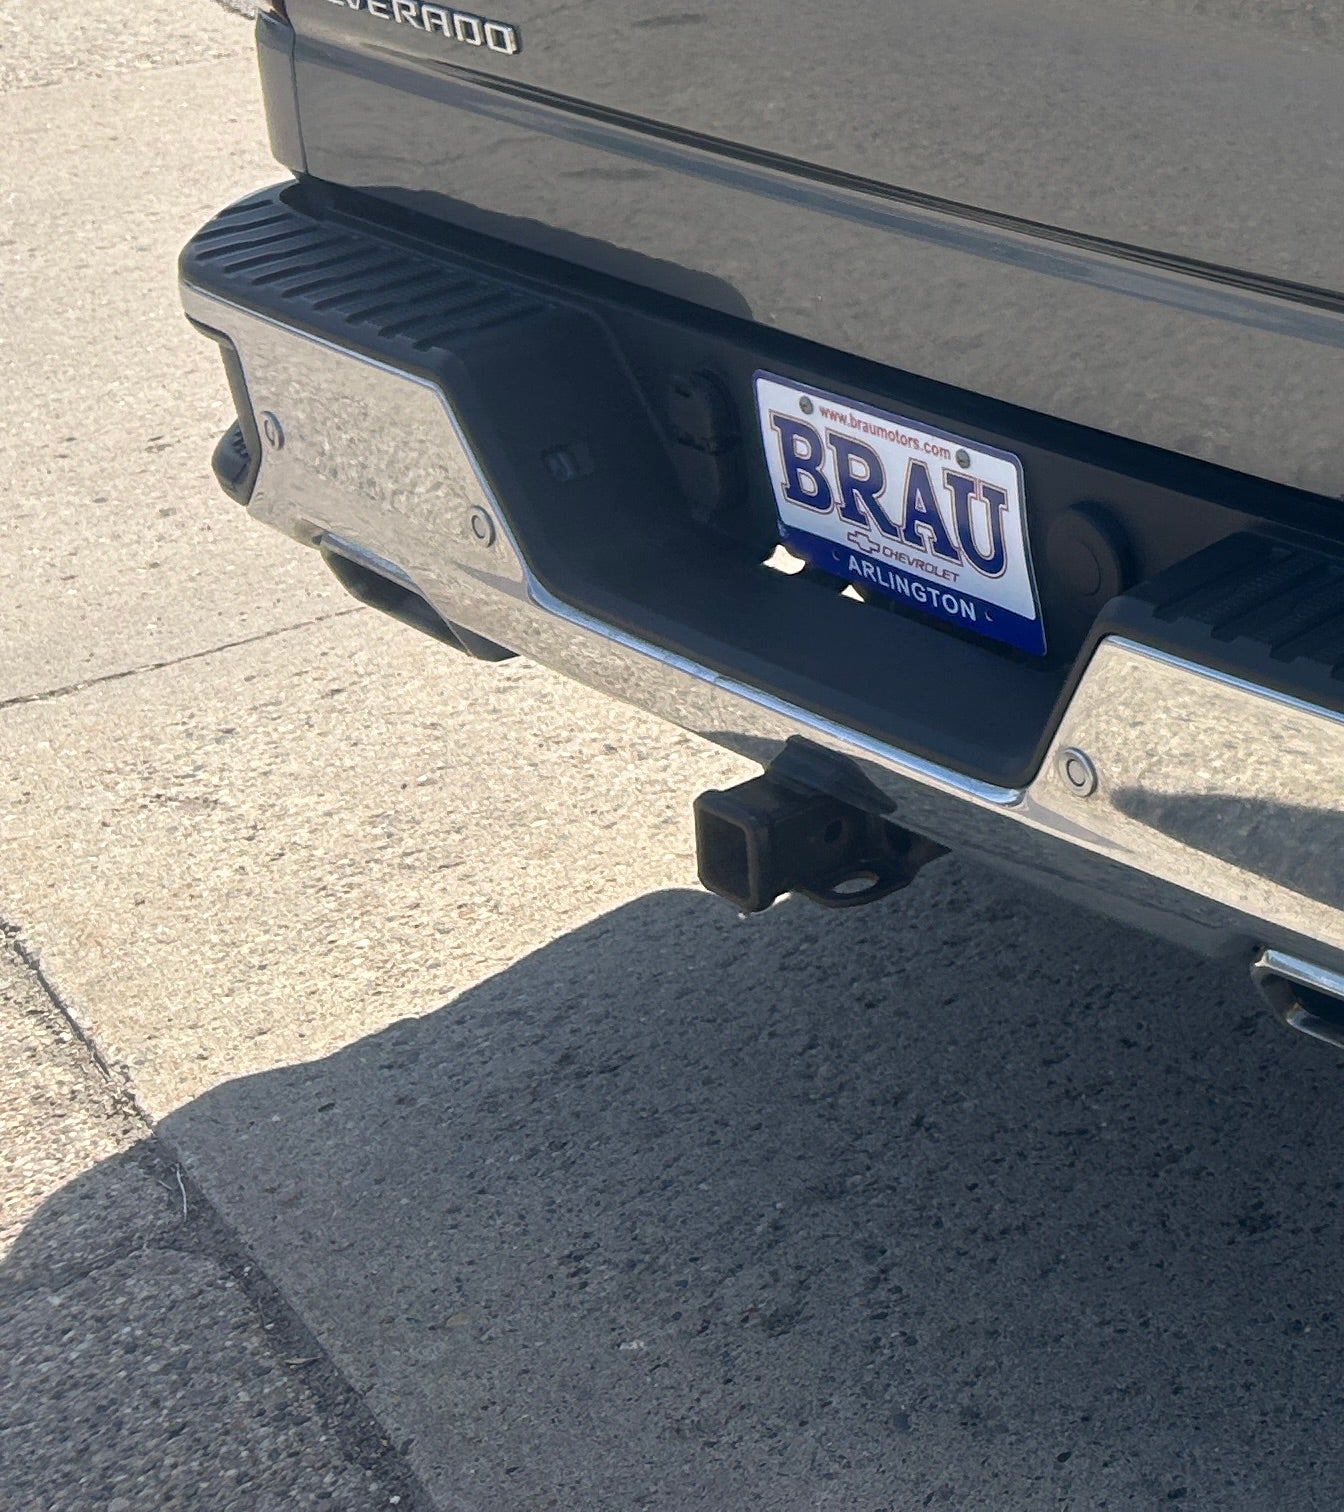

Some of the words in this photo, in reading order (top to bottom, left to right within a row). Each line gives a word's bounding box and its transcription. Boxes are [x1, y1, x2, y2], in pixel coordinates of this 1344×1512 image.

[818, 405, 952, 460] www.braumotors.com
[768, 408, 1010, 580] BRAU
[847, 555, 977, 622] ARLINGTON
[881, 545, 961, 583] CHEVROLET
